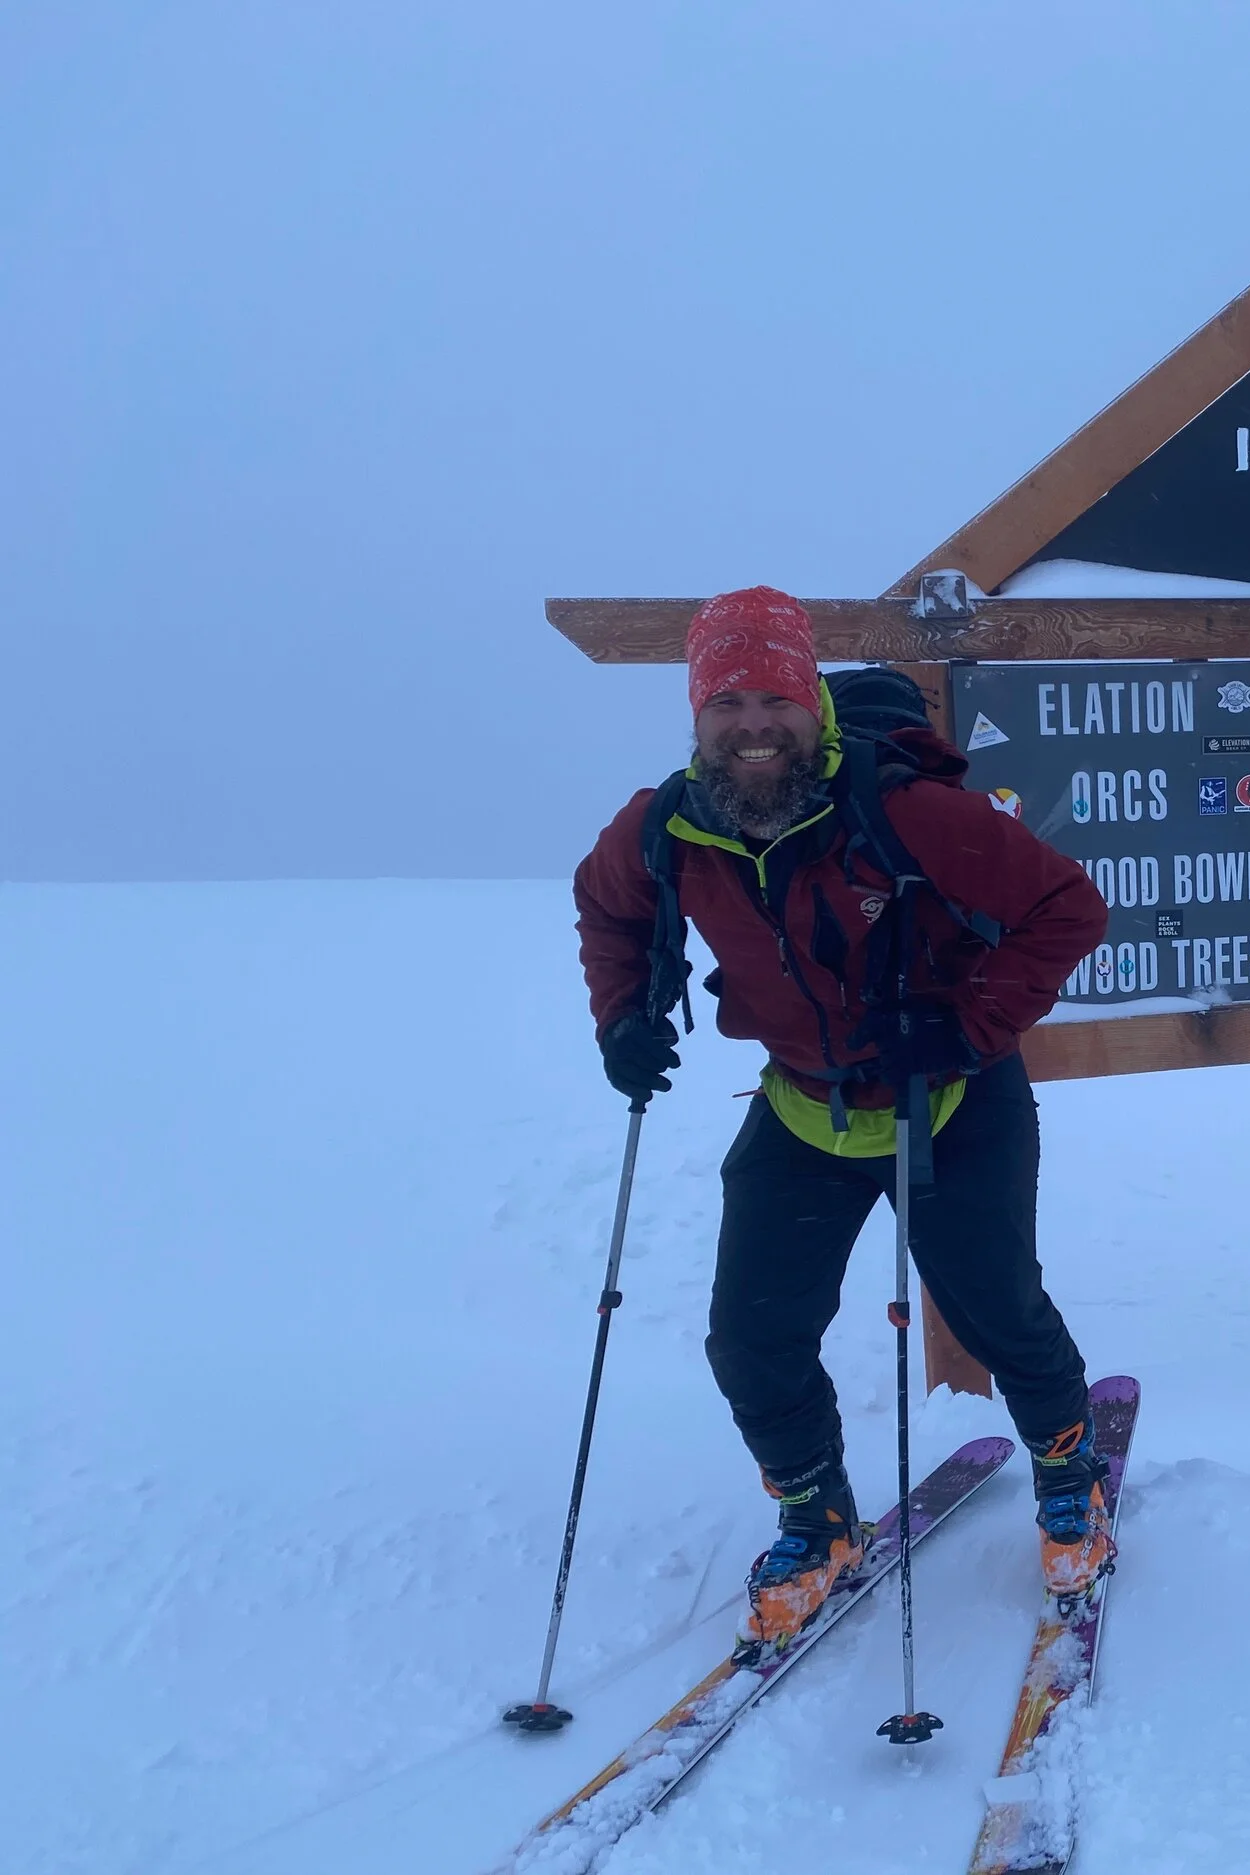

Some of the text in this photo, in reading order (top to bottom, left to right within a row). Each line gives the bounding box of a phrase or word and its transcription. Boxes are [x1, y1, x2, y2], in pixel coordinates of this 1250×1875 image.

[1038, 681, 1194, 736] ELATION
[1222, 739, 1250, 747] ELEVATION
[1072, 769, 1168, 824] ORCS
[1202, 806, 1225, 814] PANIC
[1076, 857, 1160, 909] OOD
[1058, 942, 1159, 996] WOOD
